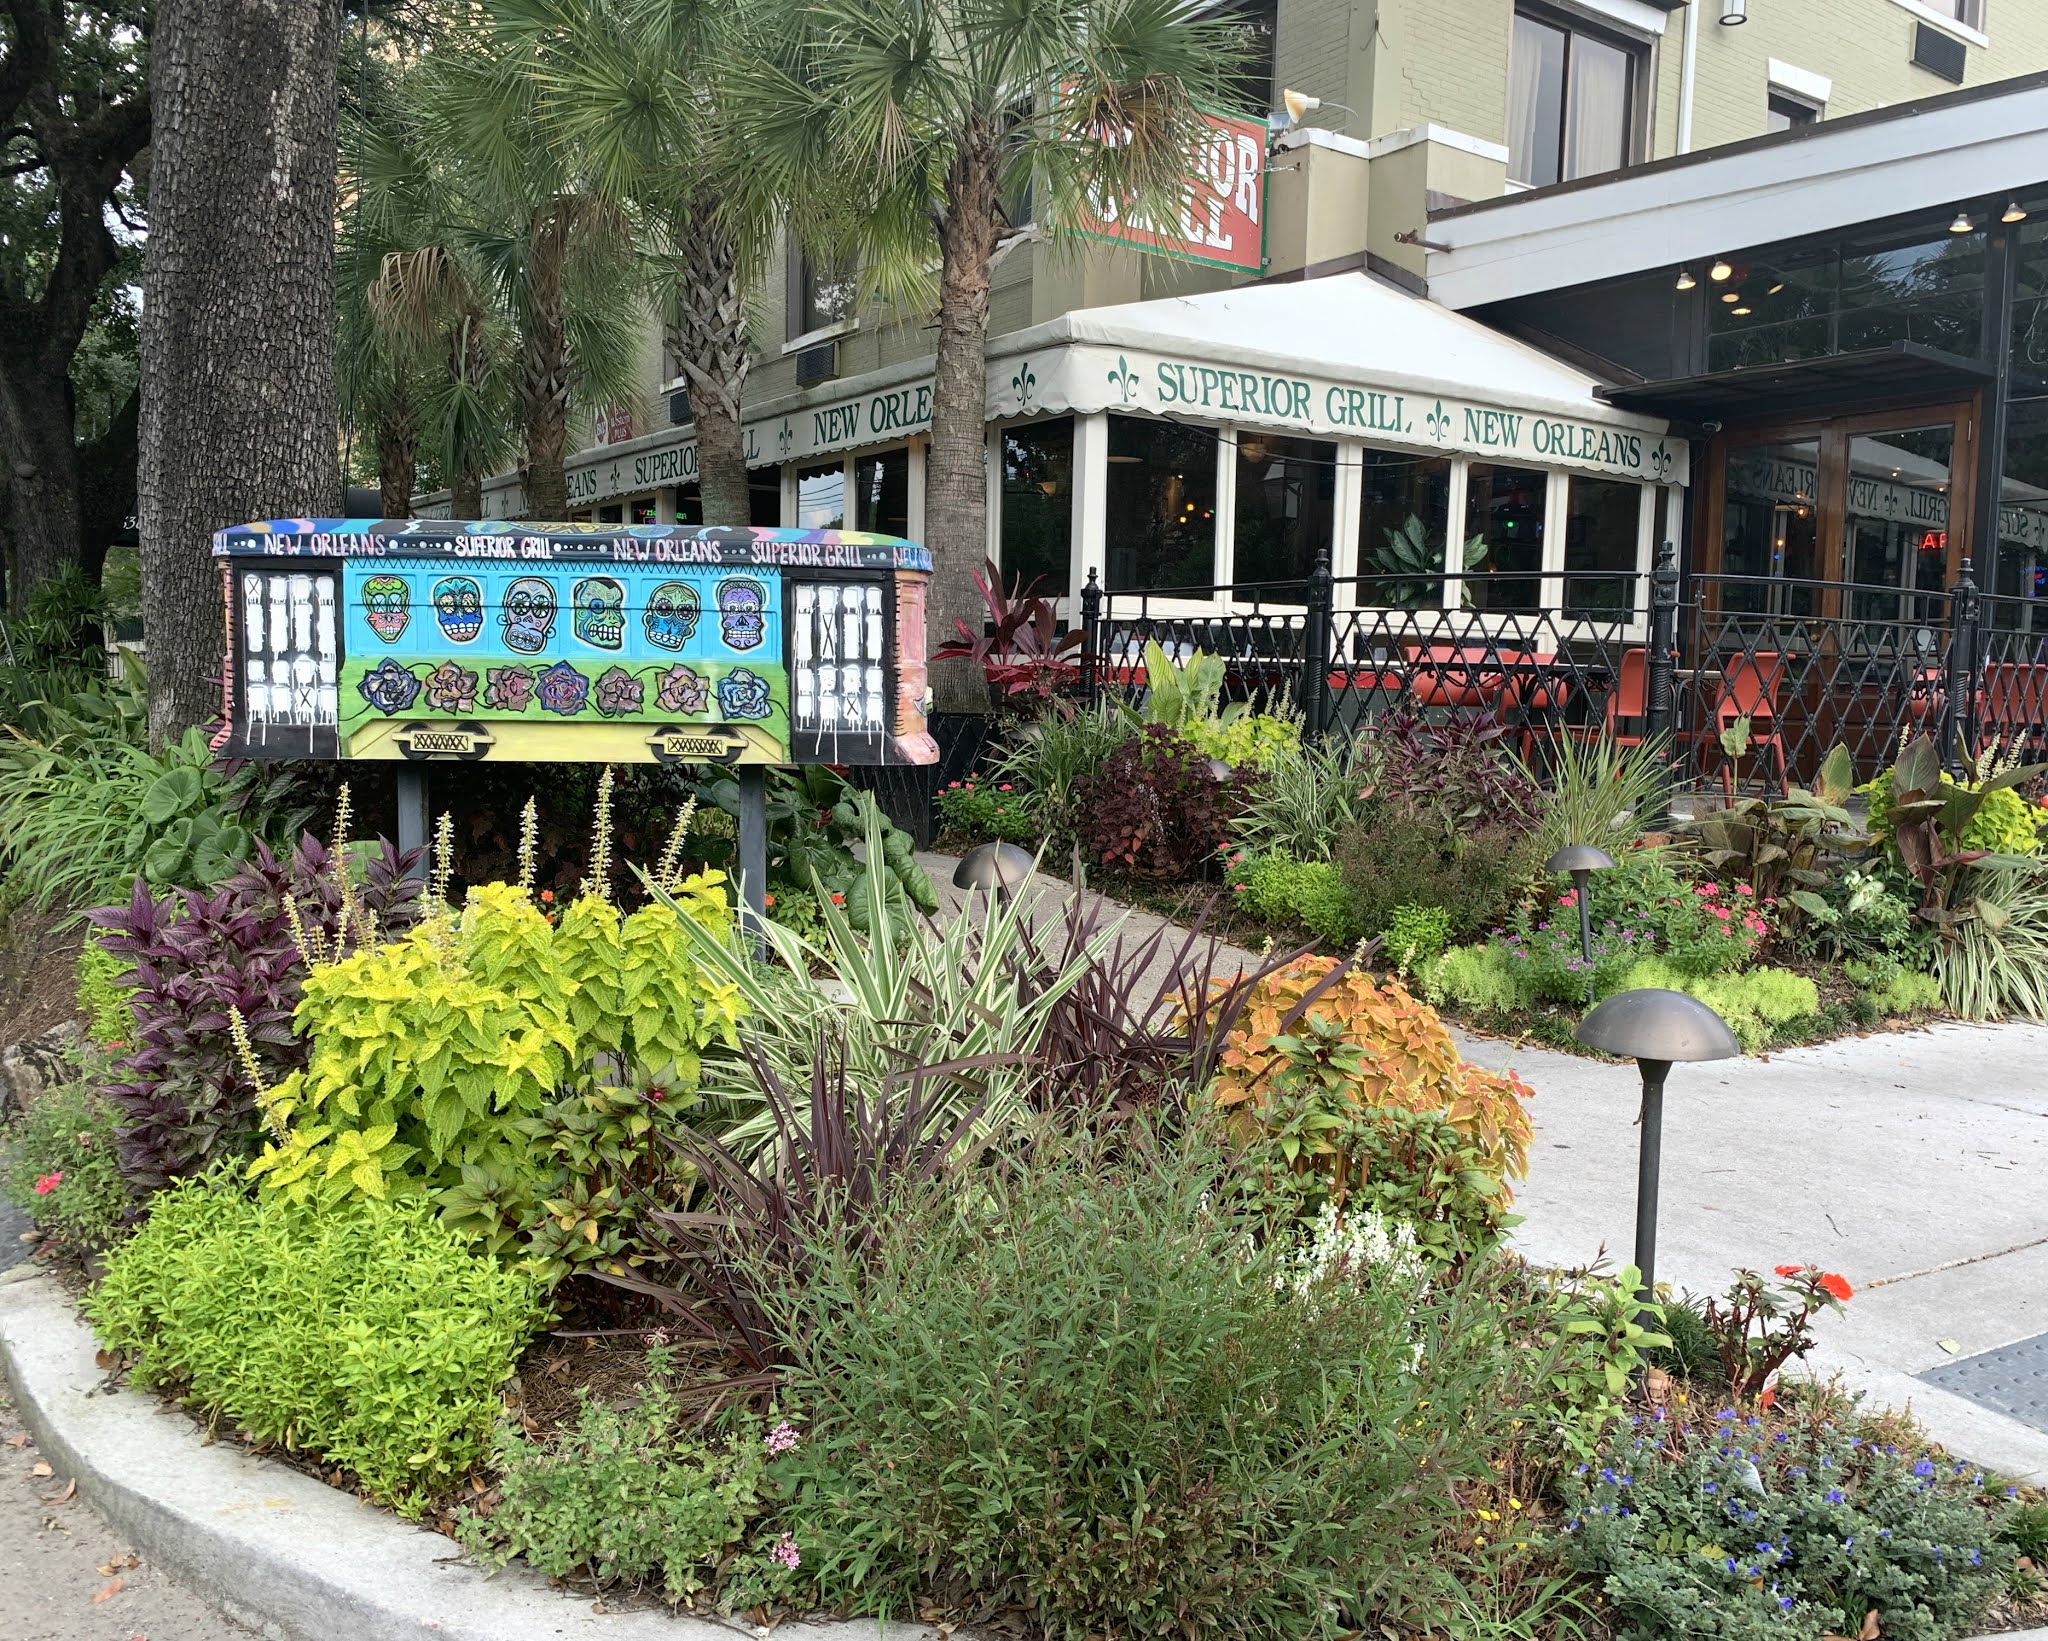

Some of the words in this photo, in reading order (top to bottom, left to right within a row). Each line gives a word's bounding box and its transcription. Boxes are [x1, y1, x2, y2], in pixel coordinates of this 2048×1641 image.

[813, 402, 860, 446] NEW
[870, 385, 932, 434] ORLE
[1157, 362, 1314, 425] SUPERIOR
[1325, 386, 1412, 434] GRILL
[1463, 407, 1523, 448] NEW
[1532, 419, 1642, 468] ORLEANS
[566, 469, 597, 499] EANS
[264, 533, 301, 555] NEW
[311, 533, 386, 557] ORLEANS
[455, 536, 517, 558] SUPERIOR
[520, 537, 553, 559] GRILL
[613, 538, 650, 560] NEW
[655, 539, 722, 563] ORLEANS
[751, 542, 823, 565] SUPERIOR
[824, 546, 864, 567] GRILL
